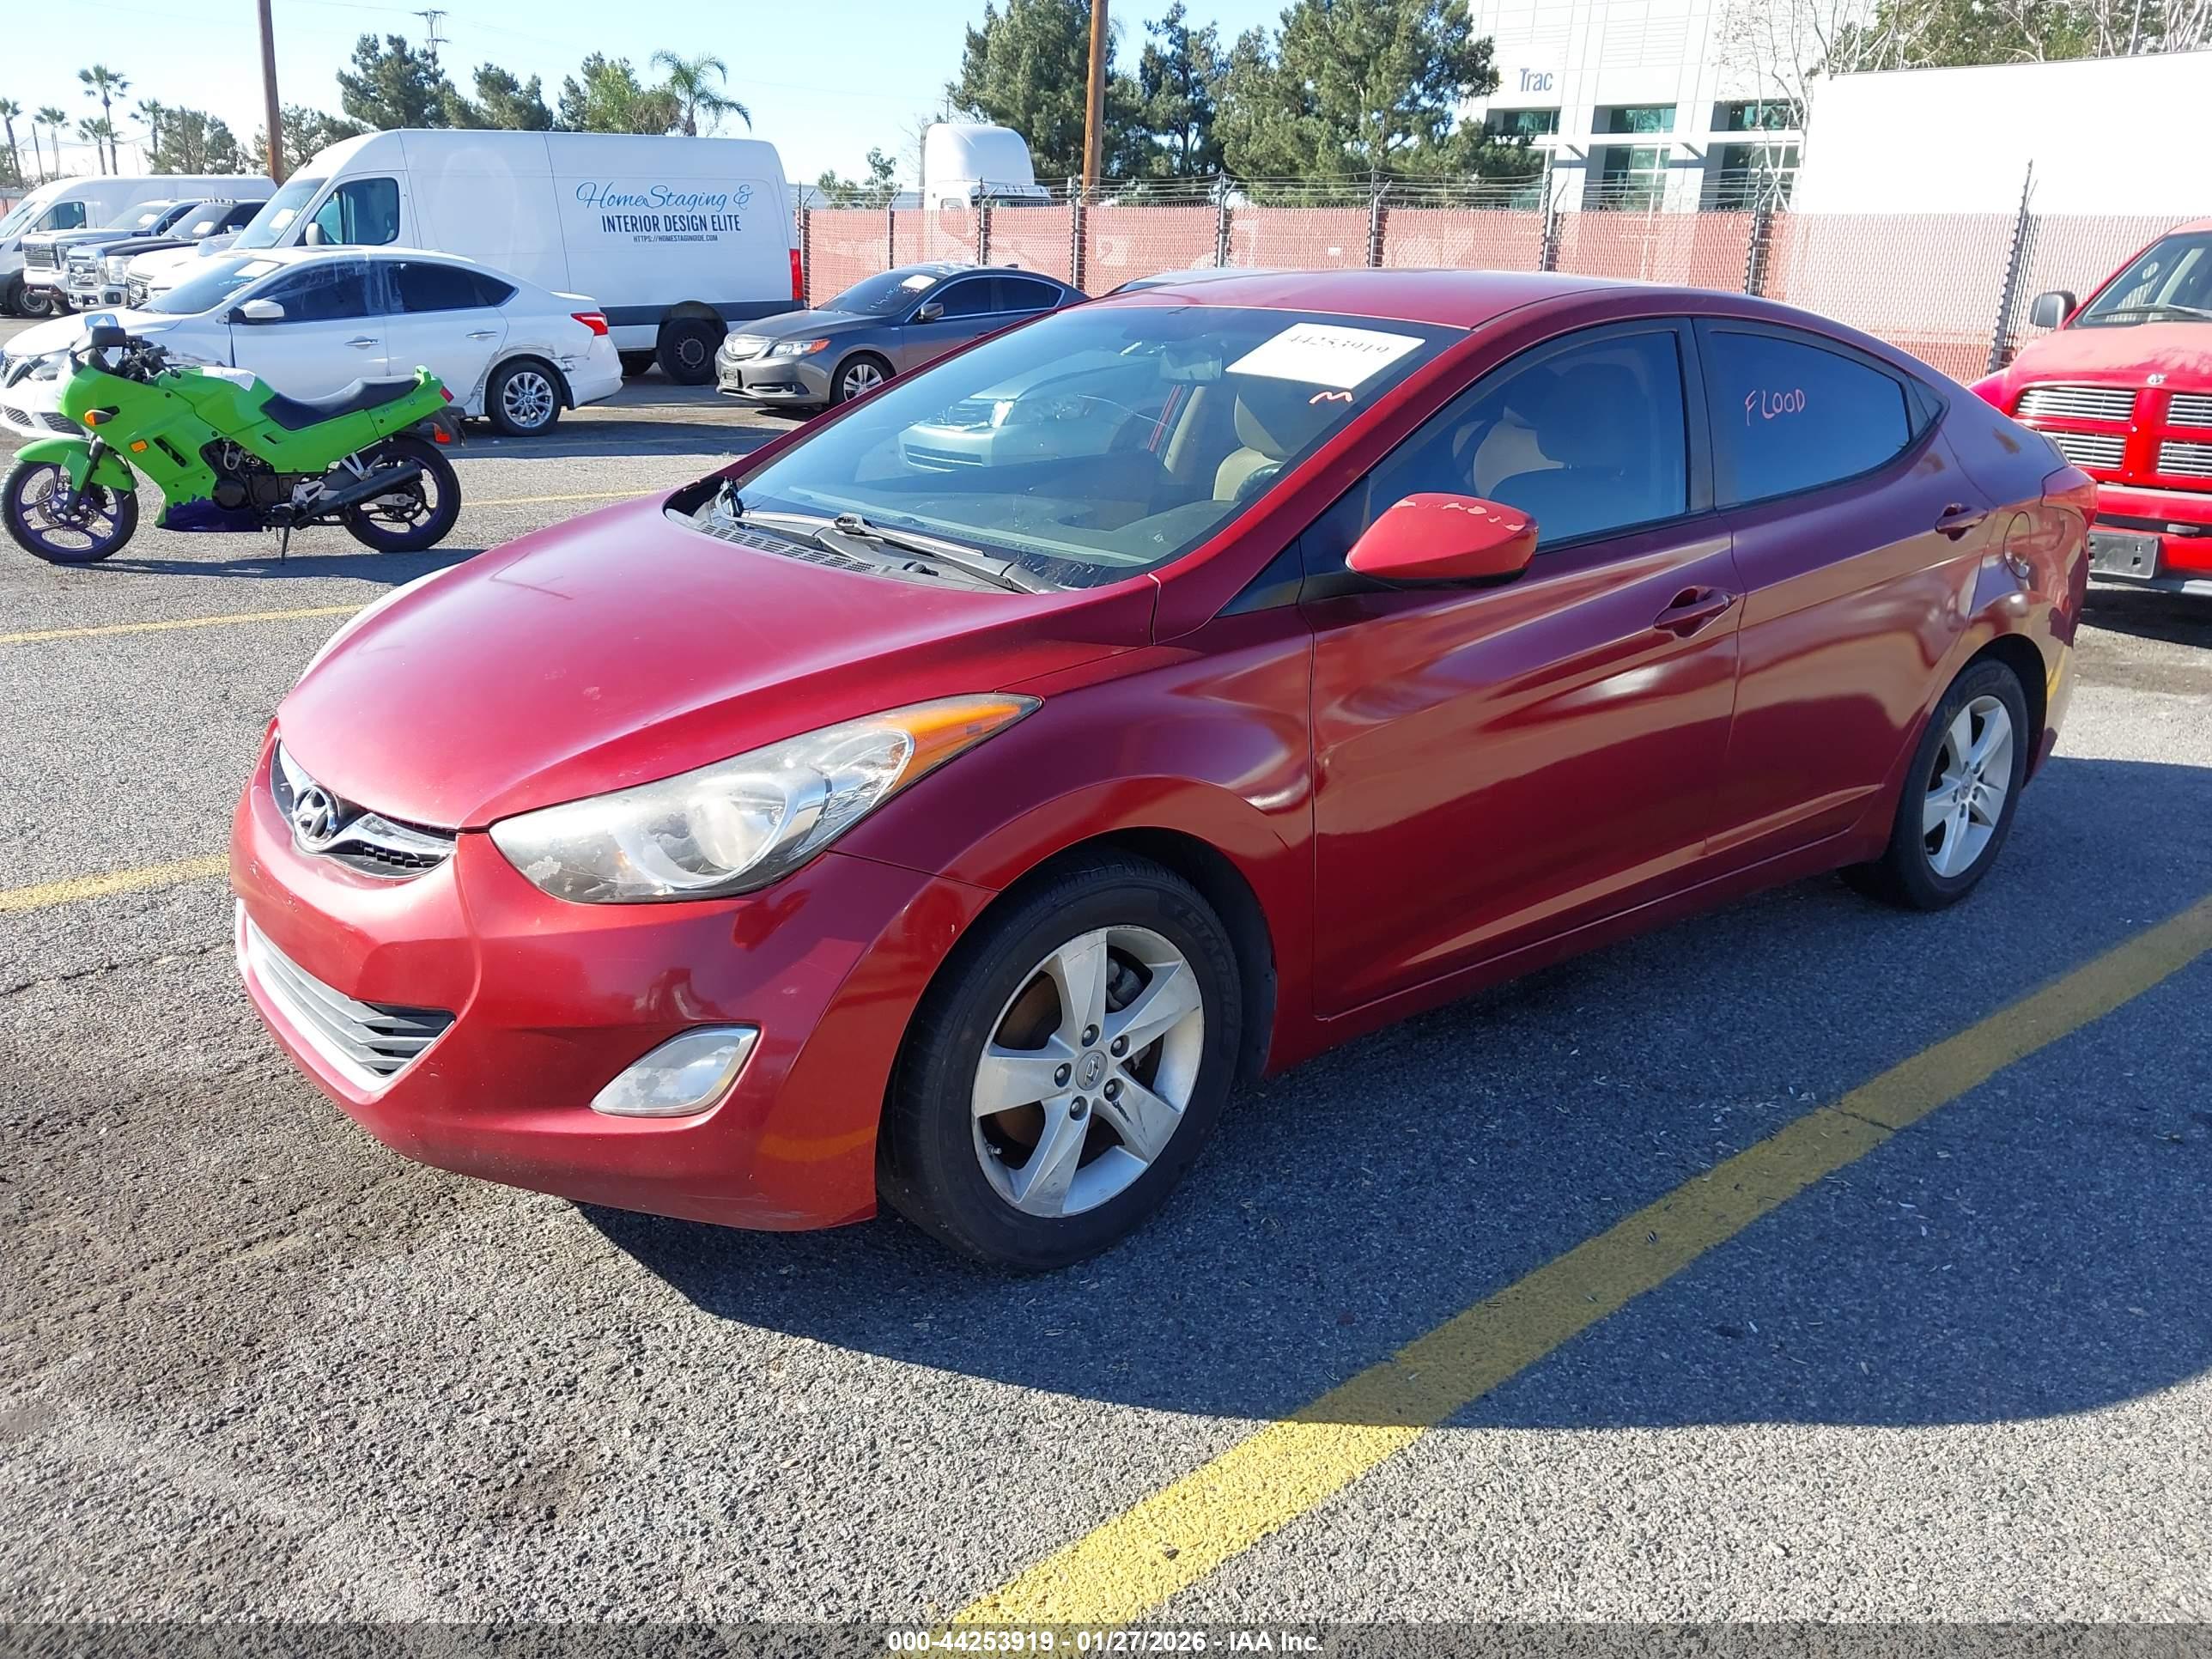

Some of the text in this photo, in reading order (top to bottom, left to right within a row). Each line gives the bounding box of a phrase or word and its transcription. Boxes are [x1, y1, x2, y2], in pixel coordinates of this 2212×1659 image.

[1520, 68, 1553, 92] Trac
[733, 184, 753, 210] &
[601, 214, 741, 233] INTERIOR DESIGN ELITE
[1744, 389, 1806, 427] FLOOD
